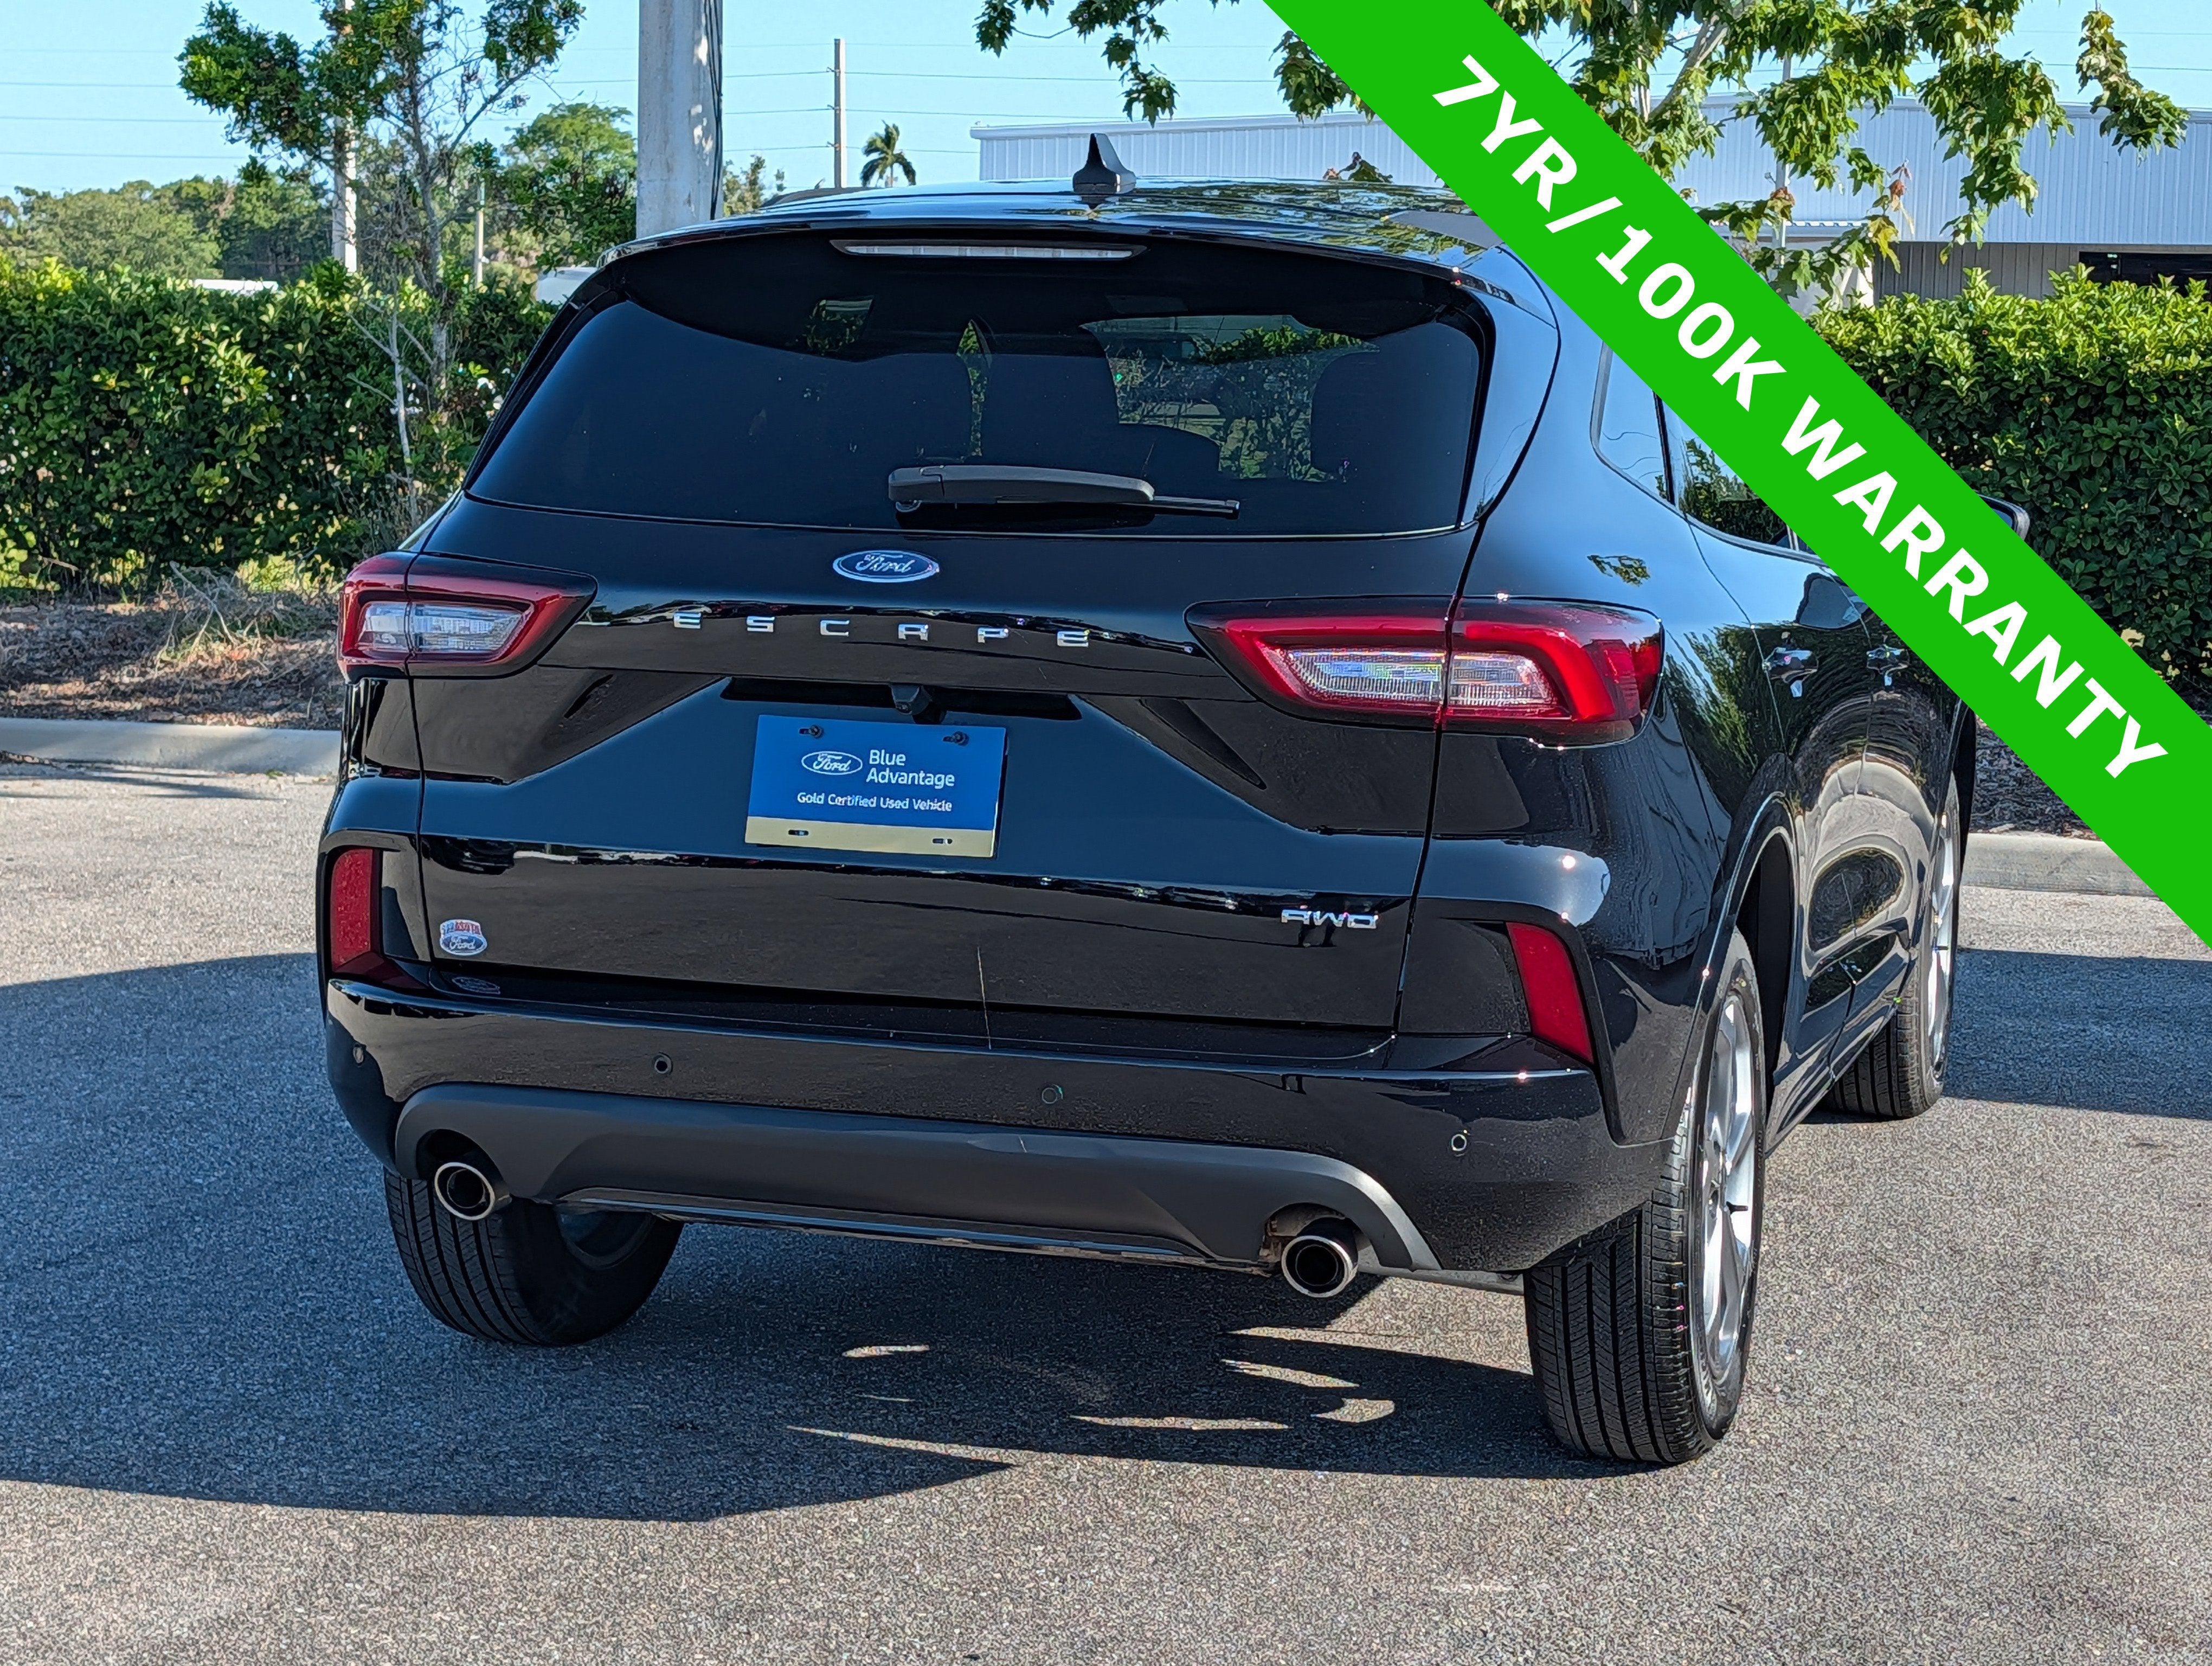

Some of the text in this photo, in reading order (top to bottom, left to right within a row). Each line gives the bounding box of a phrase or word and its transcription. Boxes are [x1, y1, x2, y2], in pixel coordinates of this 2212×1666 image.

[855, 553, 916, 573] Ford
[673, 611, 1090, 648] ESCAPE
[813, 753, 851, 772] Ford
[869, 749, 906, 766] Blue
[866, 767, 955, 790] Advantage
[797, 792, 952, 812] Gold Certified Used Vehicle
[1281, 908, 1377, 929] AWD
[449, 935, 476, 950] Ford
